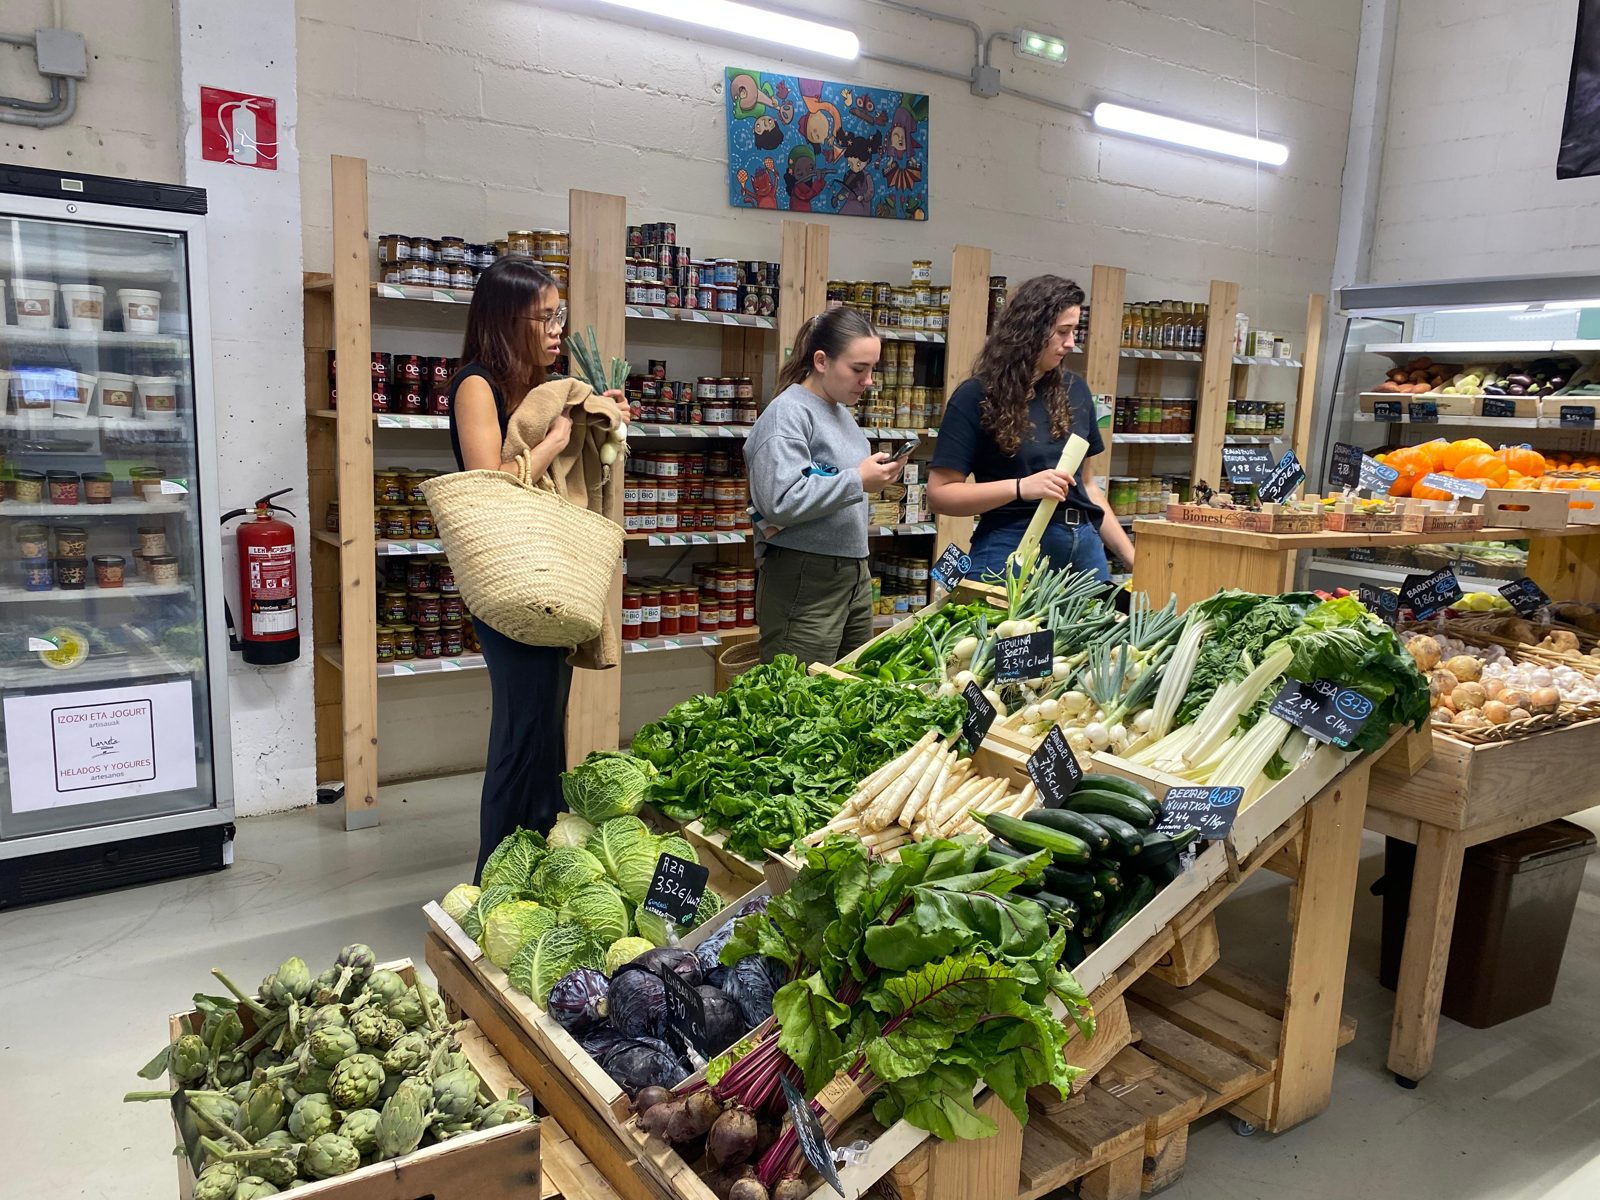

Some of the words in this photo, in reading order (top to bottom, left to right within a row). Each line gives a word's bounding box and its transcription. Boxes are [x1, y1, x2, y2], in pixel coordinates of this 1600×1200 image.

[1182, 509, 1224, 524] Bionest
[1431, 517, 1457, 529] Bionest
[1285, 692, 1320, 714] 2,84
[1340, 693, 1370, 714] 373
[57, 714, 88, 724] IZOZKI
[90, 712, 107, 721] ETA
[110, 708, 146, 719] JOGURT
[60, 765, 101, 777] HELADOS
[112, 759, 151, 770] YOGURES
[90, 772, 124, 781] artesanos
[1167, 788, 1209, 800] BERTAKO
[1166, 800, 1211, 811] KUIATXOA
[1163, 811, 1190, 824] 2,44
[662, 857, 685, 878] AZA
